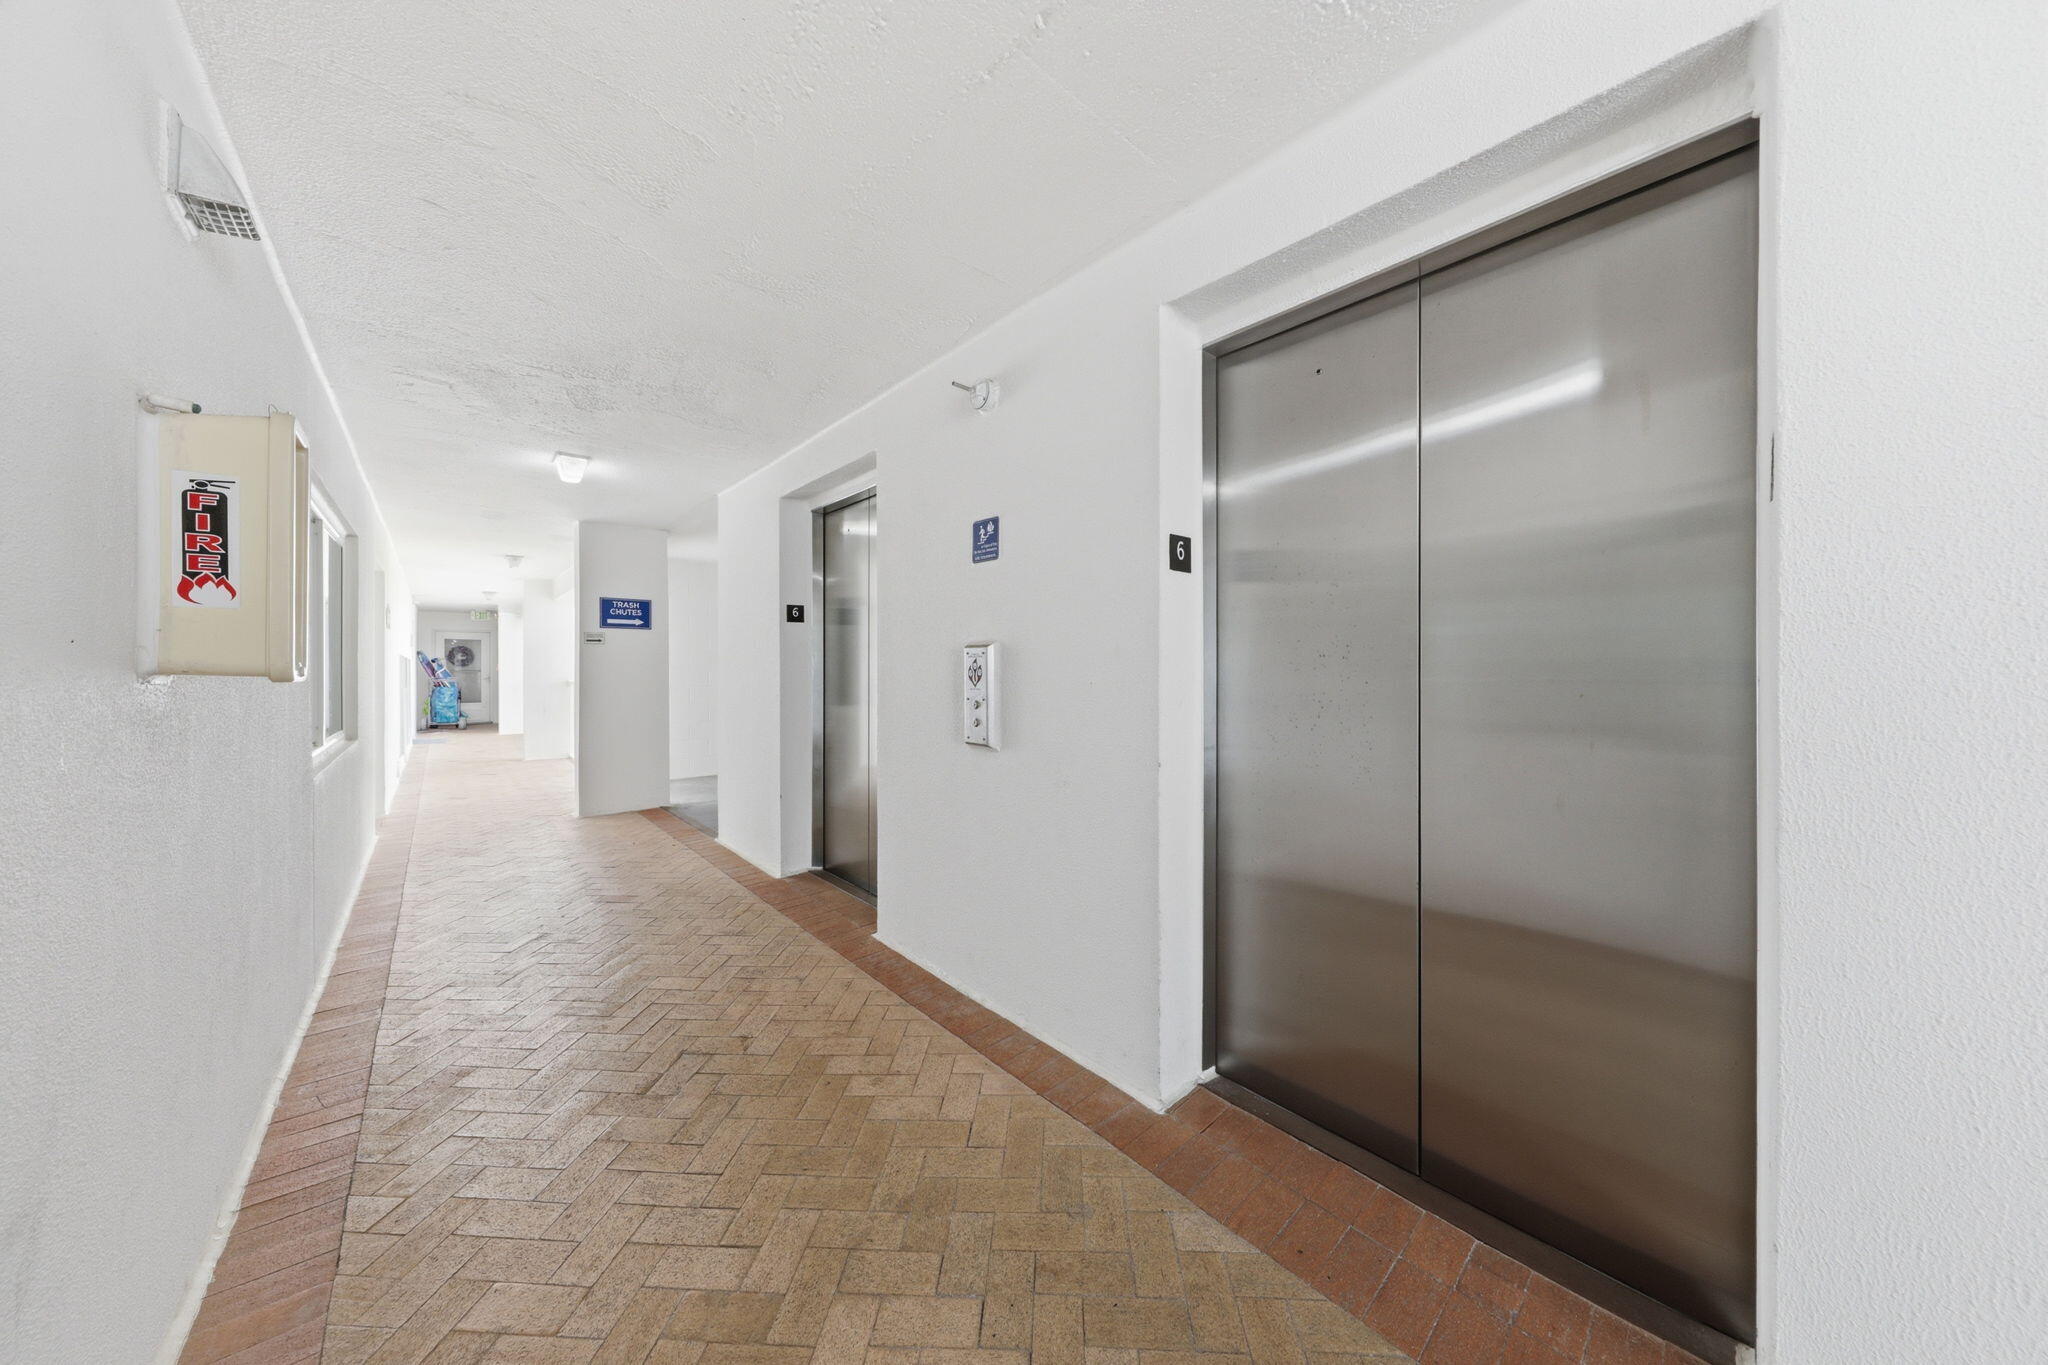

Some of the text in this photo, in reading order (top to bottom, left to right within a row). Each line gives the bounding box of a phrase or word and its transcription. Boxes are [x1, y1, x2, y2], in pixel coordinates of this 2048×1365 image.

[184, 492, 226, 572] FIRE
[1176, 540, 1185, 561] 6
[612, 601, 640, 609] TRASH
[609, 608, 642, 616] CHUTES
[792, 607, 799, 617] 6
